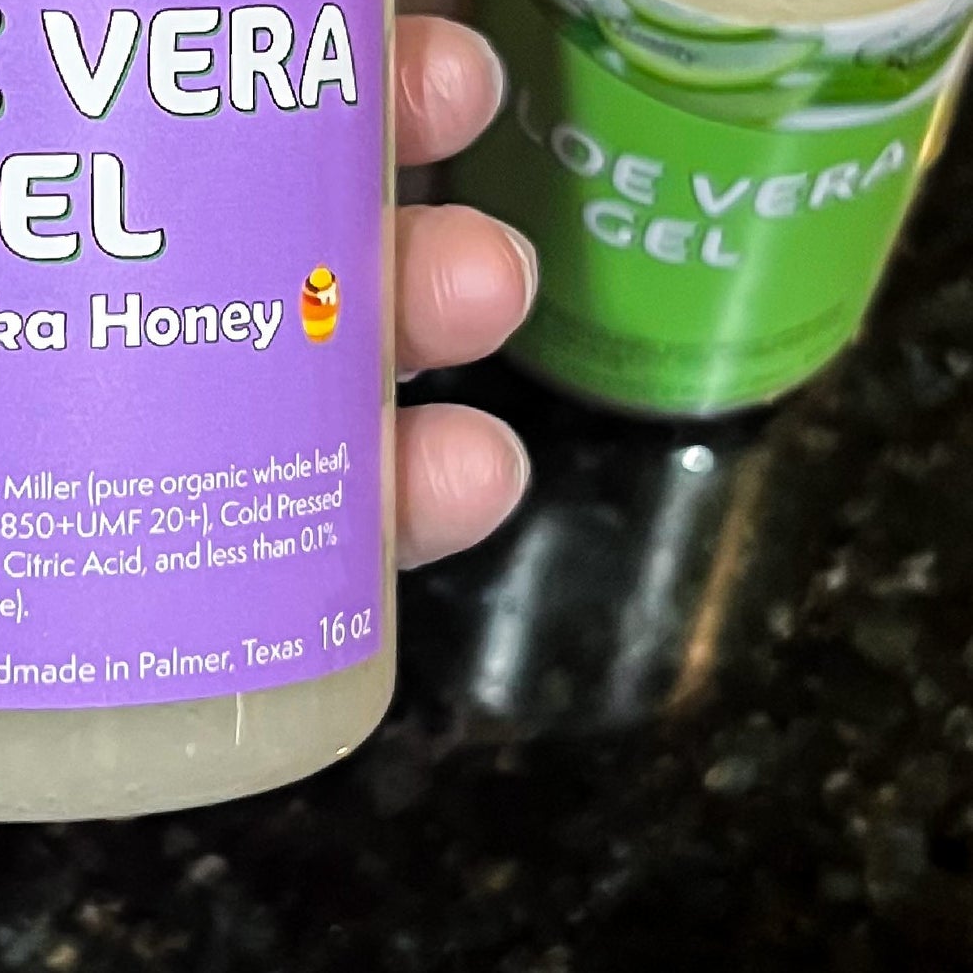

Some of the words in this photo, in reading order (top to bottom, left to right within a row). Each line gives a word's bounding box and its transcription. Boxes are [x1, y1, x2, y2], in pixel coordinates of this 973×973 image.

[41, 1, 359, 119] VERA
[691, 139, 906, 219] VERA
[582, 197, 743, 269] GEL
[89, 292, 285, 351] Honey
[4, 470, 81, 501] Miller
[86, 470, 154, 508] (pure
[159, 463, 249, 501] organic
[253, 452, 312, 486] whole
[314, 441, 352, 476] leaf),
[0, 509, 143, 541] 850+UMF
[148, 502, 214, 537] 20+),
[219, 495, 272, 528] Cold
[276, 479, 343, 521] Pressed
[2, 549, 76, 579] Citric
[81, 545, 148, 577] Acid,
[154, 540, 202, 573] and
[206, 539, 248, 568] less
[252, 531, 296, 561] than
[300, 521, 338, 554] 0.1%
[104, 655, 129, 682] in
[138, 646, 235, 680] Palmer,
[241, 637, 304, 667] Texas
[318, 611, 346, 651] 16
[350, 607, 372, 638] oz
